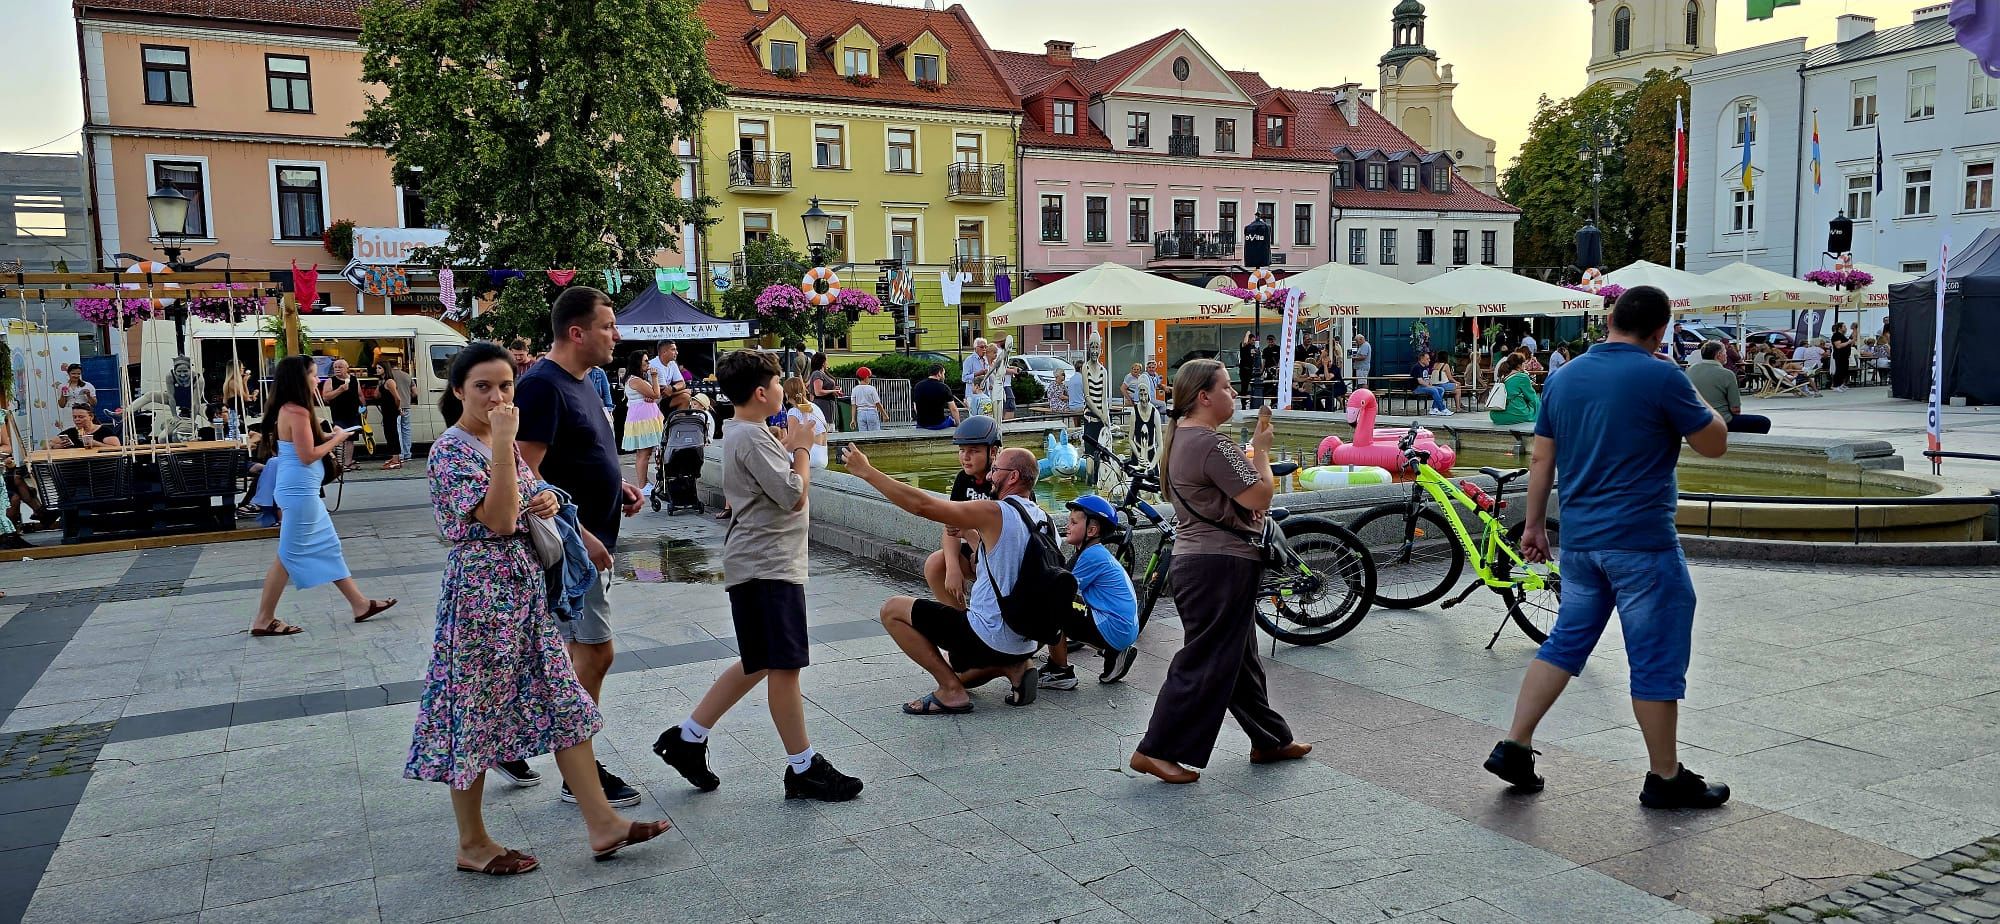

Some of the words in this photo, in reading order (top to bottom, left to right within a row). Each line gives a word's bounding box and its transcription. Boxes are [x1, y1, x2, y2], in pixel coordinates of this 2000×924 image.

[1730, 293, 1752, 303] TYSKIE
[1785, 292, 1800, 301] TYSKIE
[1868, 293, 1888, 301] TYSKI
[1198, 304, 1233, 314] TYSKIE
[1477, 304, 1507, 313] TYSKIE
[1561, 300, 1590, 309] TYSKIE
[1045, 306, 1066, 318] TYSKIE
[1085, 305, 1122, 316] TYSKIE
[1329, 305, 1360, 315] TYSKIE
[1424, 306, 1452, 315] TYSKIE
[992, 315, 1009, 325] TYSKIE
[633, 325, 683, 334] PALARNIA
[691, 324, 719, 333] KAWY
